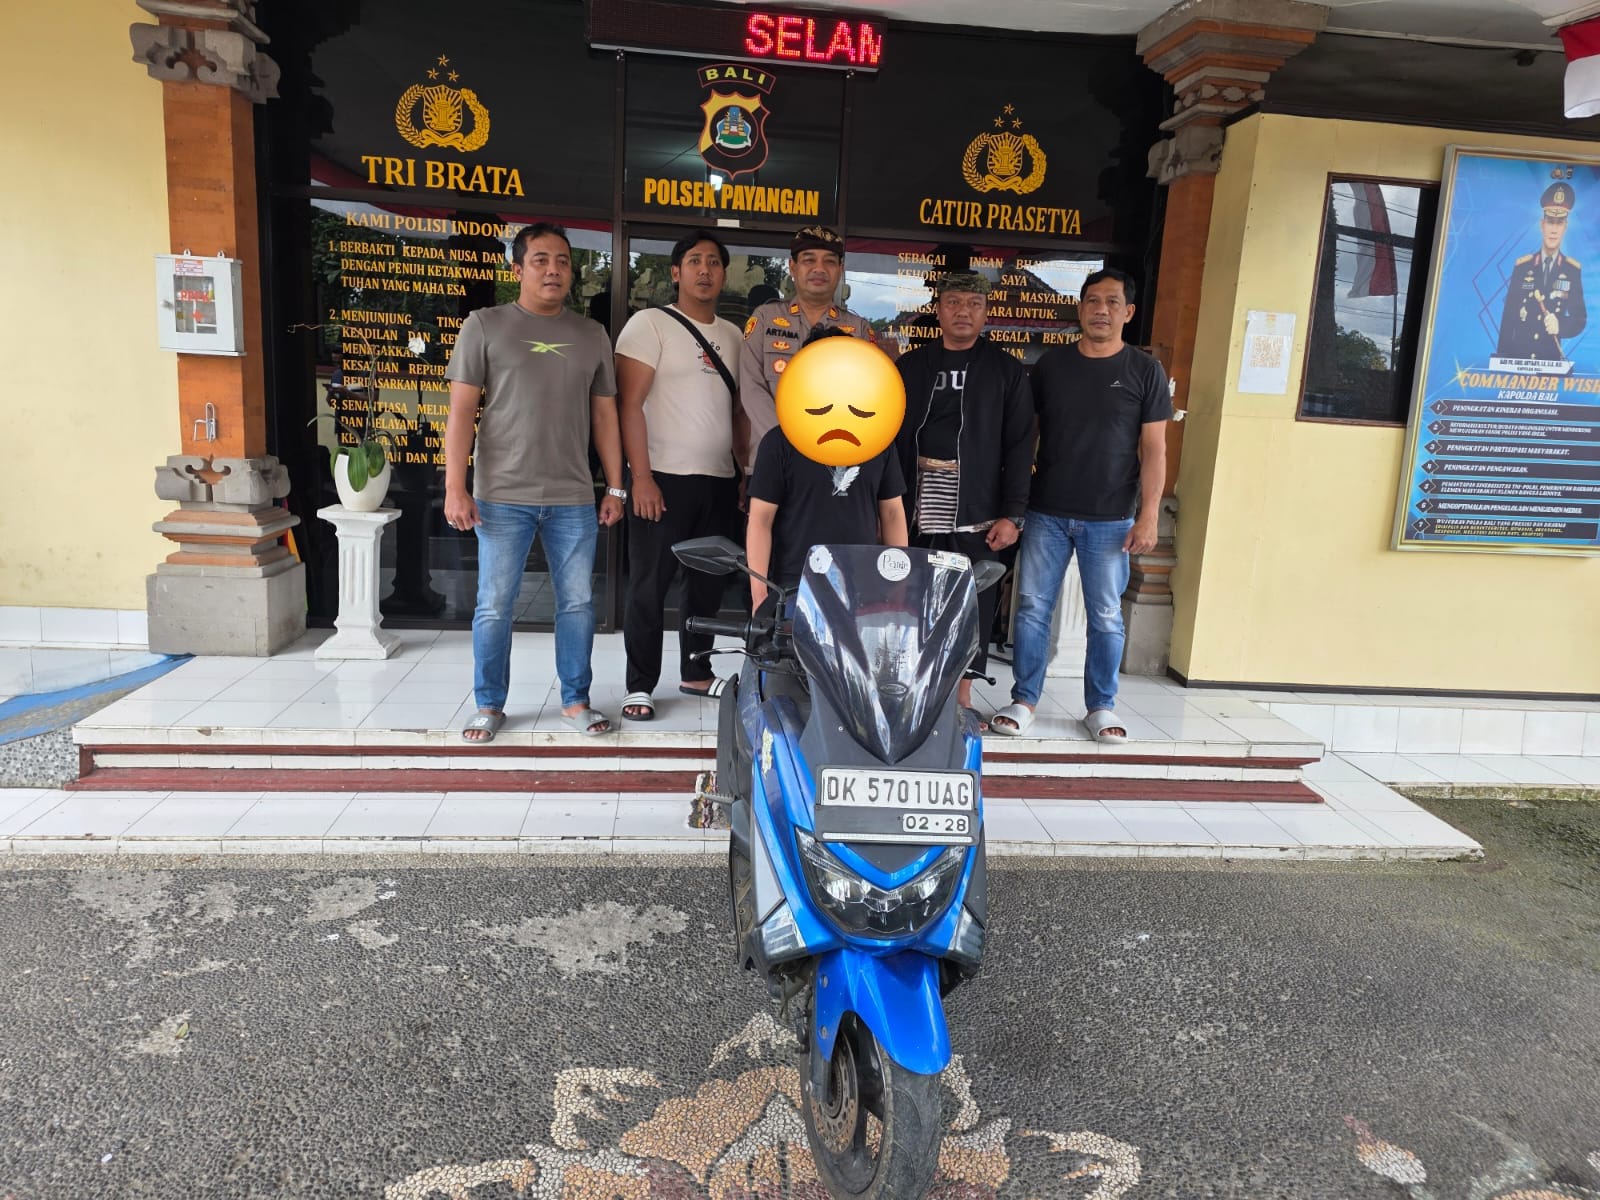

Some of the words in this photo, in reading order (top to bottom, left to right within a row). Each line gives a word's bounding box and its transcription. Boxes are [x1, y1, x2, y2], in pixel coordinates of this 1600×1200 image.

[744, 13, 882, 64] SELAN
[705, 65, 766, 86] BALI
[361, 155, 416, 187] TRI
[425, 160, 525, 197] BRATA
[644, 178, 716, 209] POLSEK
[721, 183, 819, 216] PAYANGAN
[346, 211, 389, 228] KAMI
[394, 215, 447, 233] POLISI
[452, 220, 522, 238] INDONES
[919, 198, 982, 229] CATUR
[987, 203, 1082, 236] PRASETYA
[340, 241, 395, 257] BERBAKTI
[402, 245, 445, 260] KEPADA
[450, 249, 477, 263] NUSA
[482, 251, 505, 264] DAN
[898, 252, 947, 266] SEBAGAI
[970, 256, 1003, 269] INSAN
[341, 258, 385, 273] DENGAN
[388, 262, 425, 276] PENUH
[427, 265, 494, 281] KETAKWAAN
[341, 276, 380, 290] TUHAN
[382, 279, 410, 292] YANG
[412, 281, 444, 295] MAHA
[447, 283, 467, 296] ESA
[1001, 274, 1027, 287] SAYA
[987, 290, 1007, 302] EMI
[329, 309, 339, 321] 2.
[341, 309, 412, 326] MENJUNJUNG
[1016, 307, 1058, 320] UNTUK:
[342, 327, 398, 341] KEADILAN
[765, 327, 800, 340] ARTAMA
[990, 330, 1030, 343] SEGALA
[342, 359, 399, 373] KESAUAN
[1459, 372, 1558, 391] COMMANDER
[1498, 390, 1537, 401] KAPOLDA
[1538, 391, 1559, 402] BALI
[341, 415, 364, 428] DAN
[366, 417, 418, 431] ELAYANI
[406, 452, 428, 464] DAN
[827, 775, 856, 802] DK
